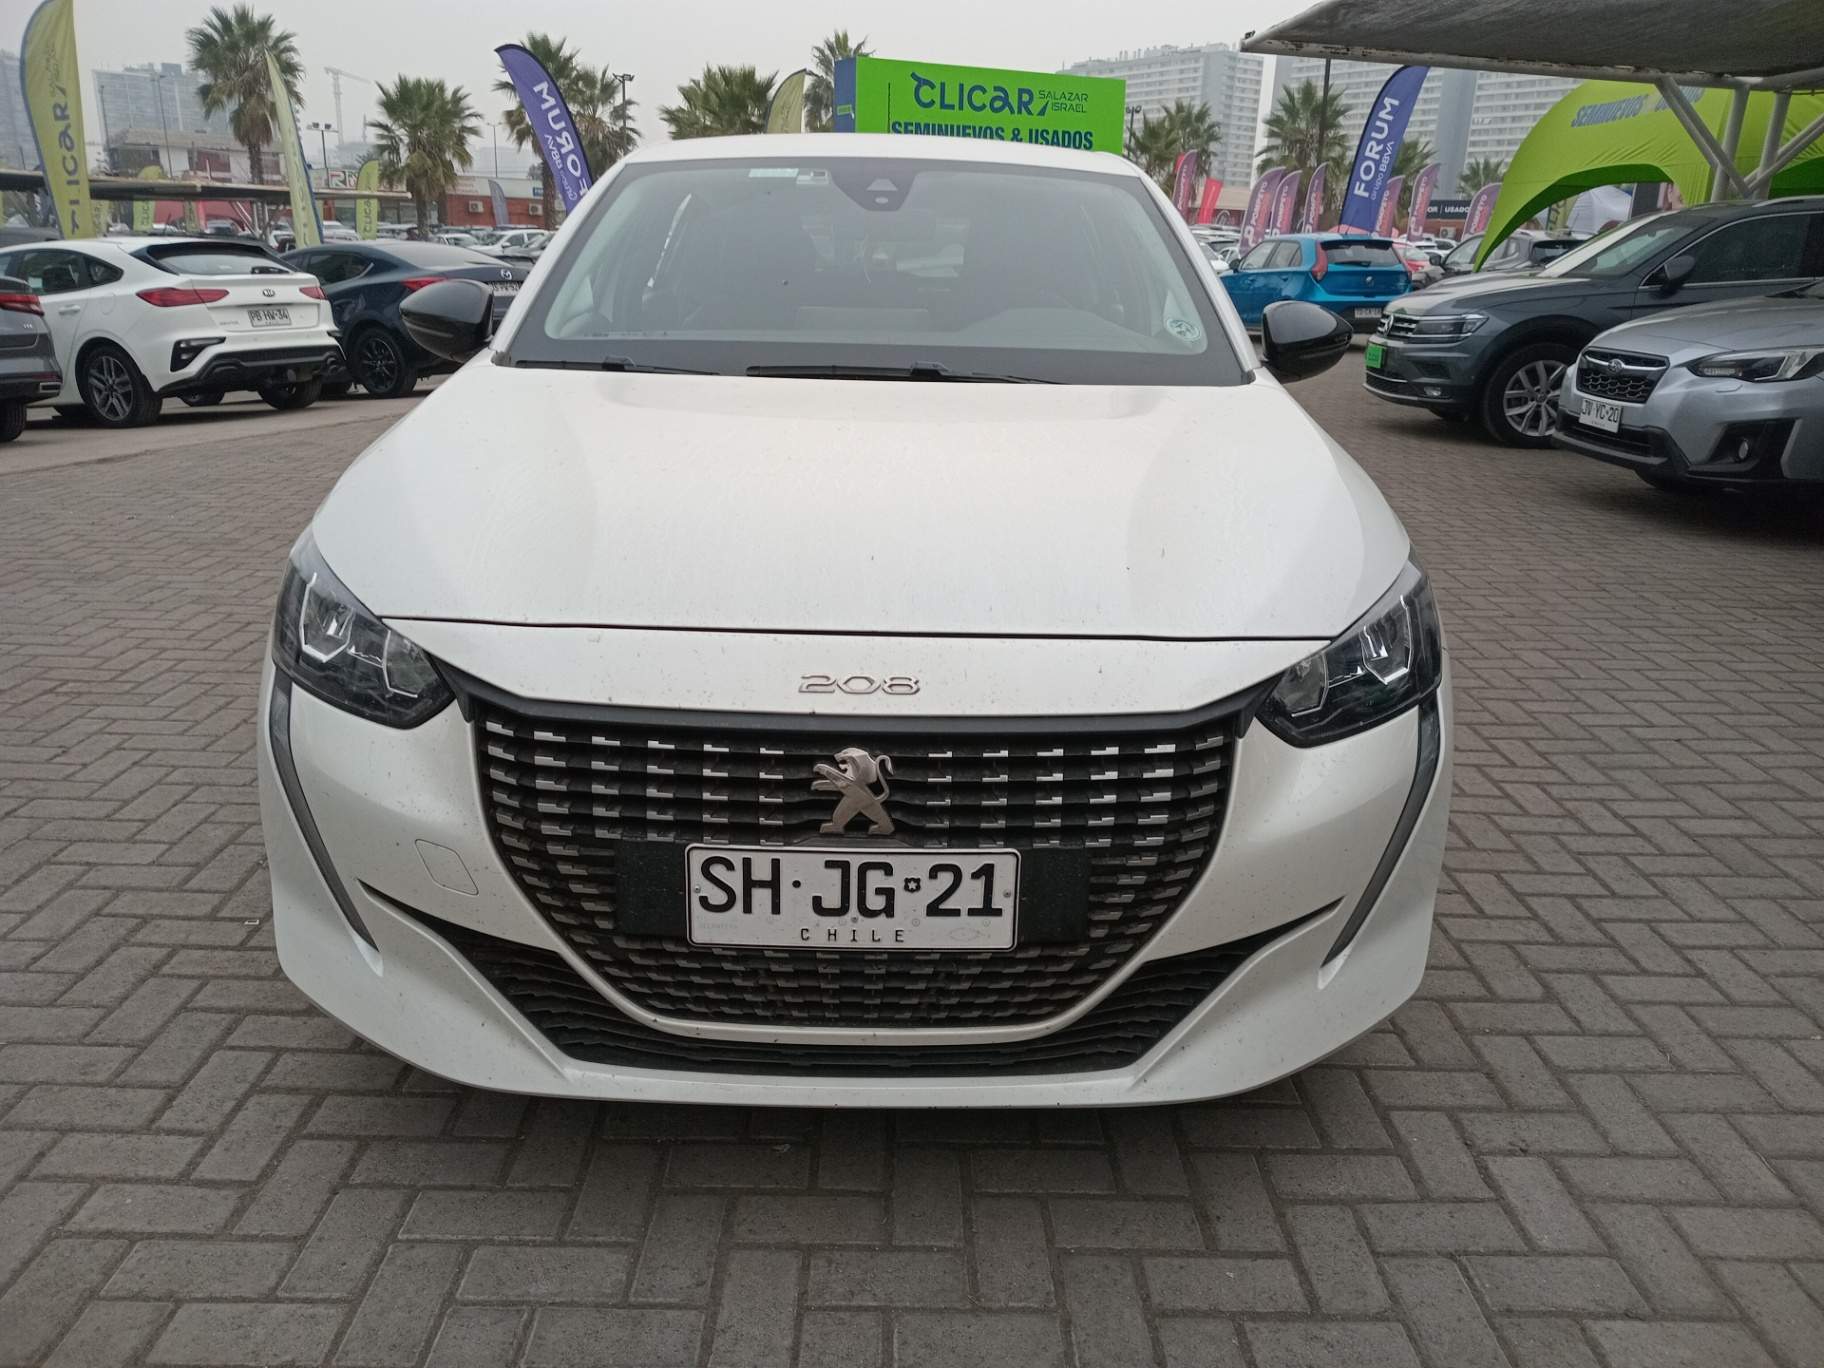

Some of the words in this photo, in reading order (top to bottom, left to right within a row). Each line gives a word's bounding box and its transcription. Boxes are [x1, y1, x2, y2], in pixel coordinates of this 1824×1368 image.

[1038, 88, 1089, 103] SALAZAR
[1050, 101, 1087, 113] ISRAEL
[1028, 128, 1094, 151] USADOS
[1353, 96, 1400, 198] FORUM
[1379, 141, 1395, 172] BBVA
[798, 674, 921, 696] 208
[799, 928, 905, 943] CHILE
